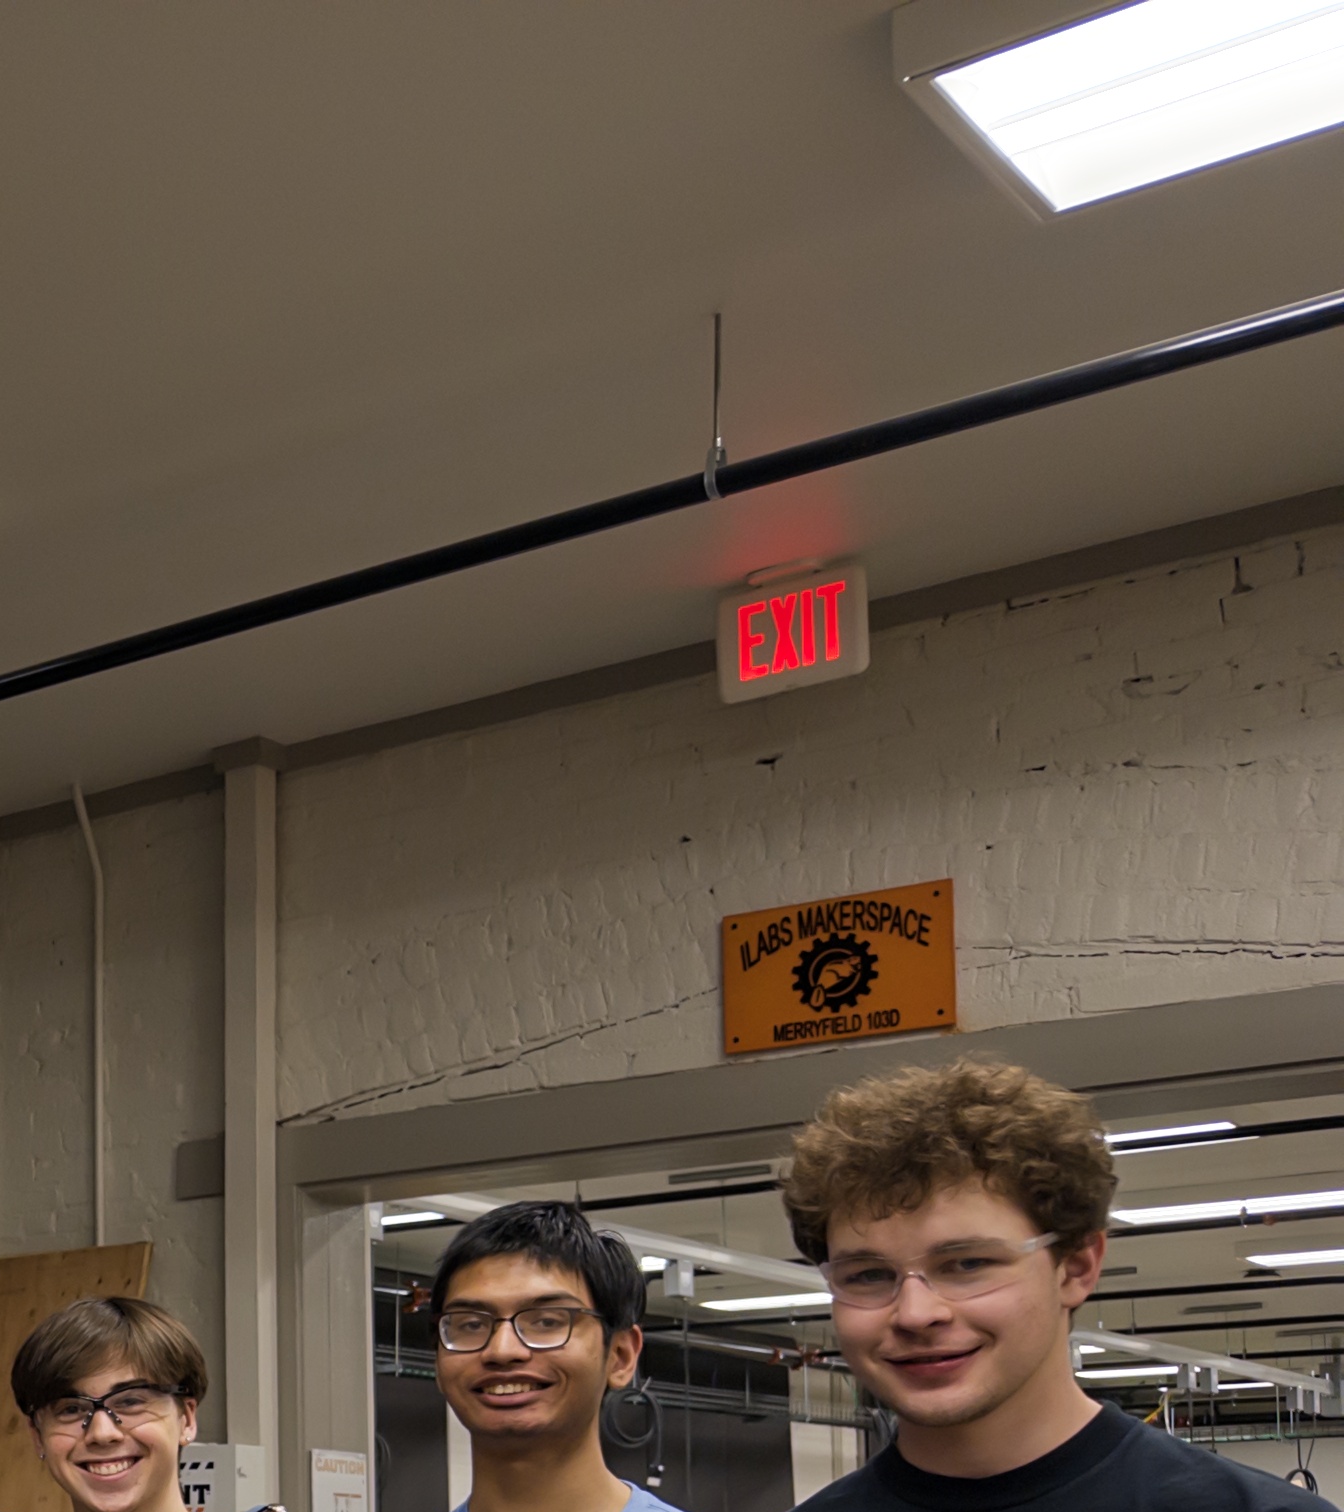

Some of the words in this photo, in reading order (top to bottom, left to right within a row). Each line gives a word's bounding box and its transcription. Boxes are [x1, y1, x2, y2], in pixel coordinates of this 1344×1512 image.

[737, 580, 846, 682] EXIT
[740, 917, 794, 971] ILABS
[797, 900, 932, 947] MAKERSPACE
[773, 1014, 862, 1042] MERRYFIELD
[867, 1009, 901, 1030] 103D
[315, 1456, 365, 1476] CAUTION
